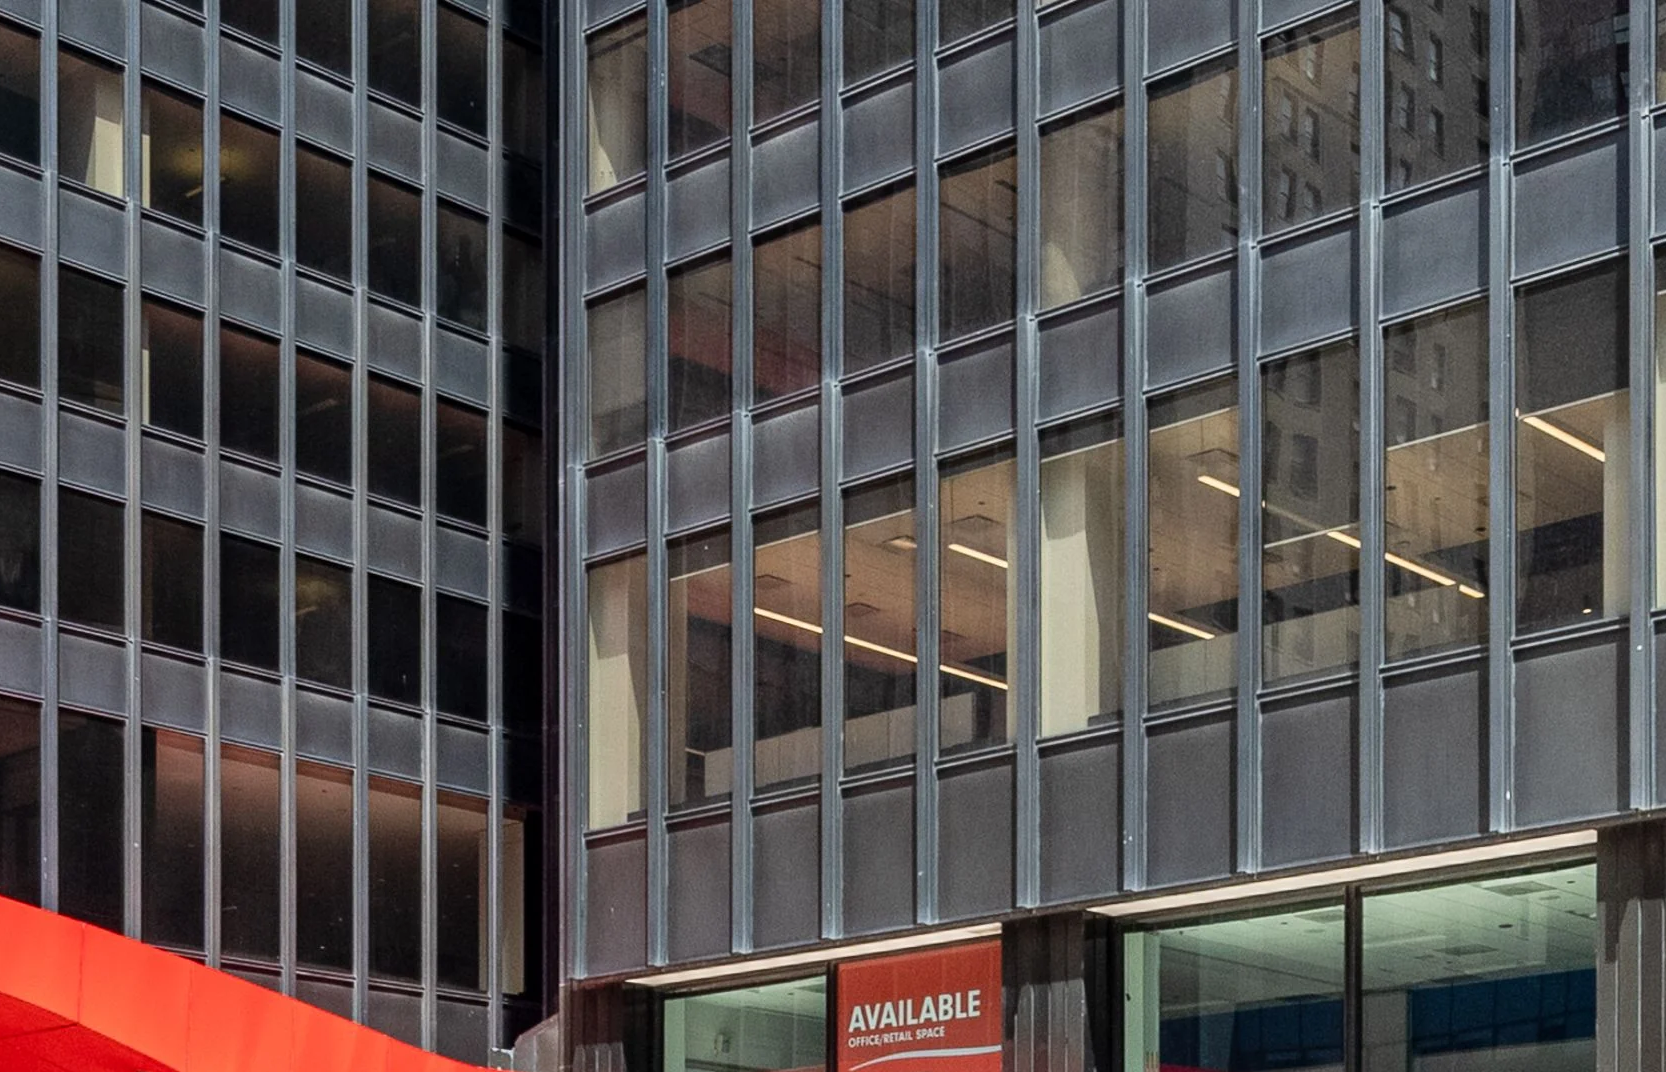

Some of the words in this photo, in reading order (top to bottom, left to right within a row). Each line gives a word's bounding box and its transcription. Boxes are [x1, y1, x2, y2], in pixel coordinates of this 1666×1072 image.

[848, 989, 981, 1033] AVAILABLE
[848, 1032, 913, 1049] OFFICE/RETAIL
[916, 1026, 946, 1041] SPACE
